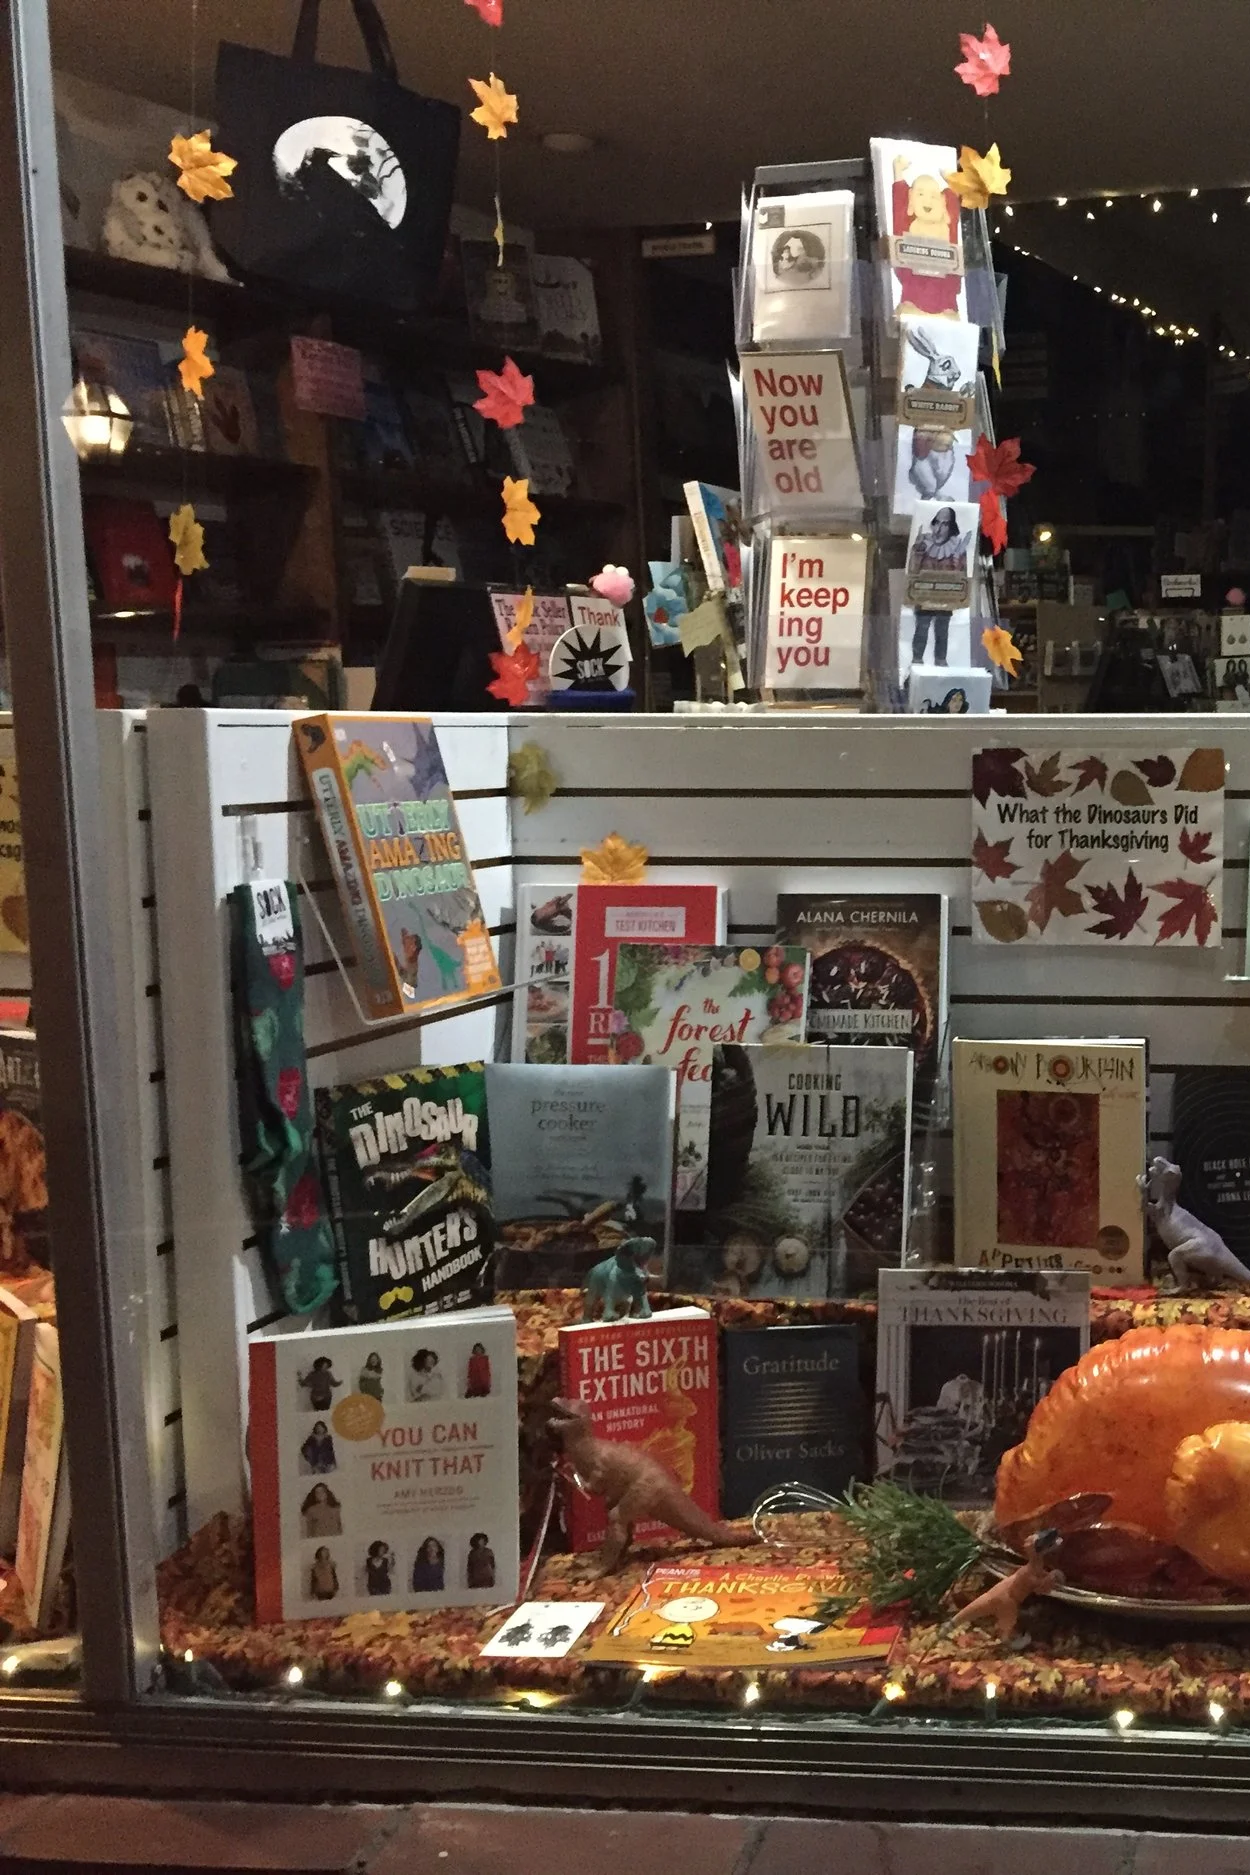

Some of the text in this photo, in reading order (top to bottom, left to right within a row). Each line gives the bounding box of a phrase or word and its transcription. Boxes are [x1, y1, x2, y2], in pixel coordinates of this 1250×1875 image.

[753, 367, 823, 397] Now
[760, 405, 819, 434] you
[767, 438, 818, 461] are
[775, 466, 824, 494] old
[781, 553, 824, 579] I'm
[780, 583, 849, 614] keep
[578, 606, 622, 627] Thank
[778, 612, 823, 644] ing
[576, 658, 606, 680] SOCK
[777, 646, 830, 673] you
[997, 803, 1199, 826] What the Dinosaurs Did
[1026, 829, 1169, 852] for Thanksgiving
[615, 919, 677, 933] TEST KITCHEN
[796, 910, 845, 924] ALANA
[850, 910, 919, 924] CHERNILA
[702, 997, 720, 1014] the
[656, 1003, 756, 1055] forest
[863, 1012, 910, 1030] KITCHEN
[788, 1073, 842, 1091] COOKING
[350, 1101, 374, 1121] THE
[530, 1099, 607, 1115] pressure
[766, 1093, 860, 1138] WILD
[349, 1096, 479, 1170] DINOSAUR
[537, 1114, 598, 1132] cooker
[1203, 1160, 1226, 1172] BLACK
[421, 1244, 483, 1292] HANDBOOK
[902, 1306, 1067, 1324] THANKSGIVING
[578, 1334, 708, 1375] THE SIXTH
[742, 1351, 840, 1376] Gratitude
[606, 1403, 659, 1421] UNNATURAL
[379, 1421, 478, 1448] YOU CAN
[606, 1418, 645, 1433] HISTORY
[736, 1439, 845, 1463] Oliver Sacks
[370, 1453, 485, 1482] KNIT THAT
[719, 1572, 790, 1582] A Charlie
